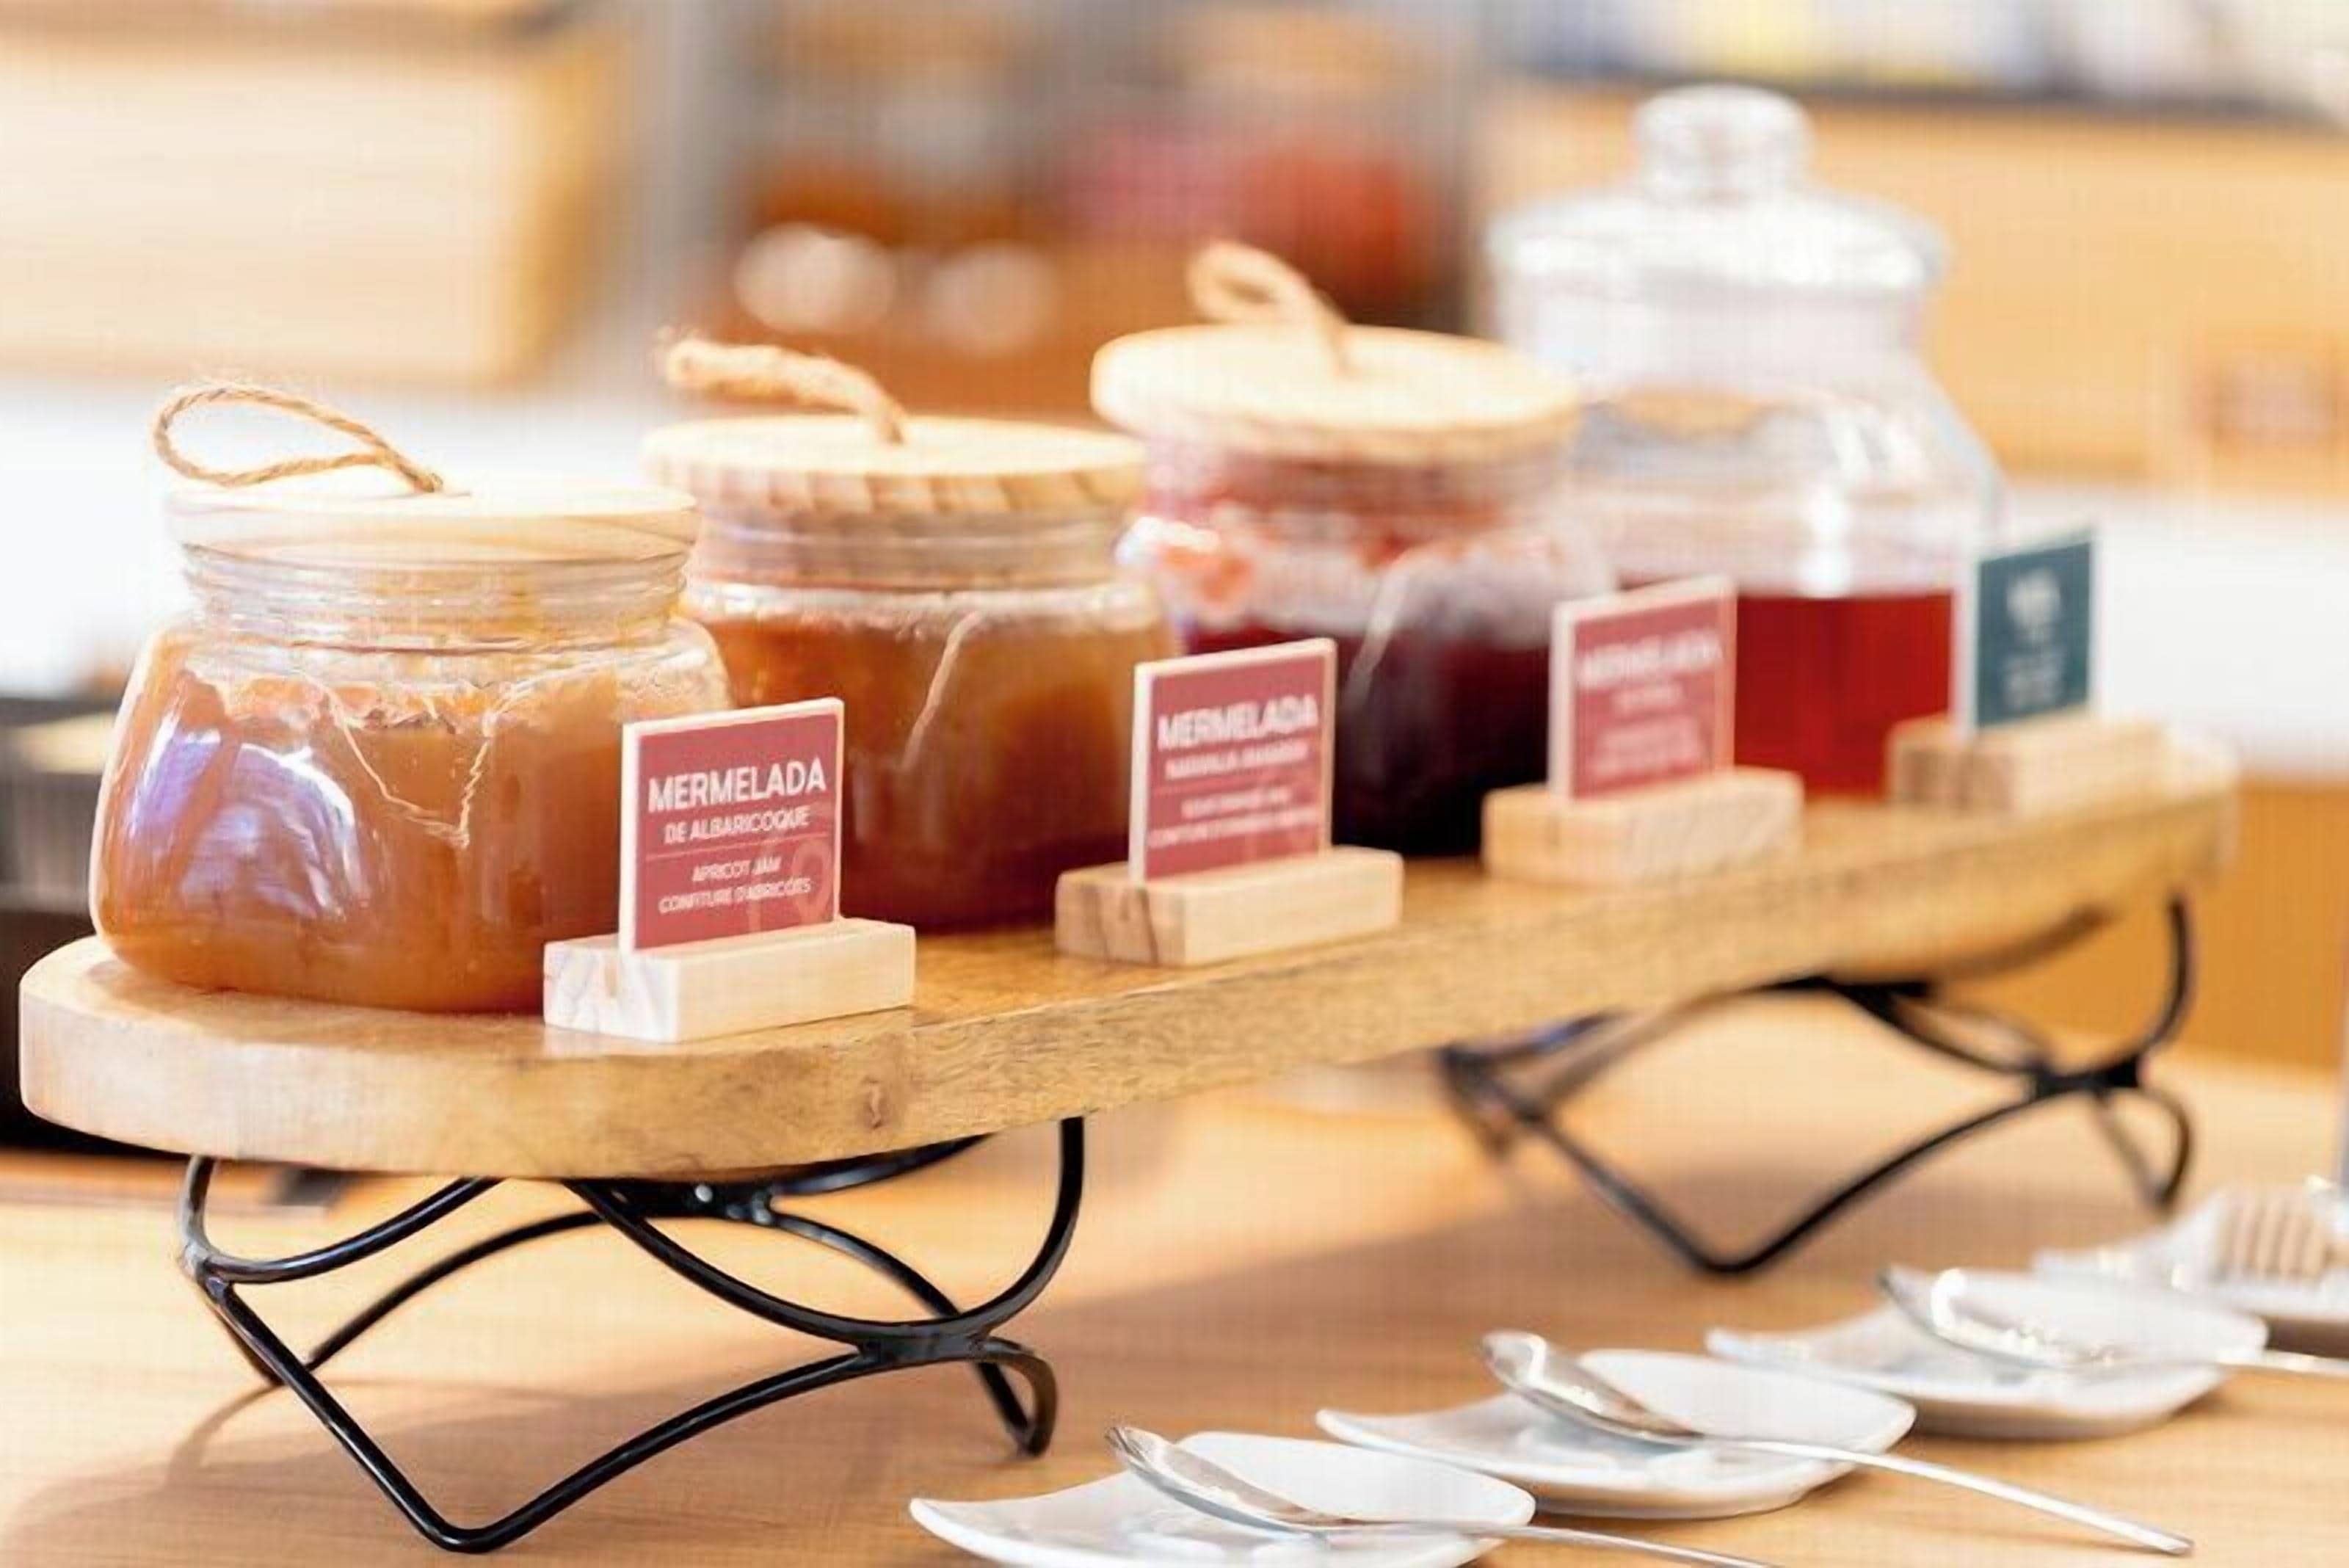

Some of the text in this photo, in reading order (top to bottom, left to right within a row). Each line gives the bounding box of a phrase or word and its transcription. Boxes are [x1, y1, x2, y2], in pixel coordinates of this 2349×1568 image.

[1157, 693, 1319, 752] MERMELADA
[648, 757, 827, 813] MERMELADA
[664, 805, 811, 844] DE ALBARICOQUE
[691, 859, 752, 882] APRICOT
